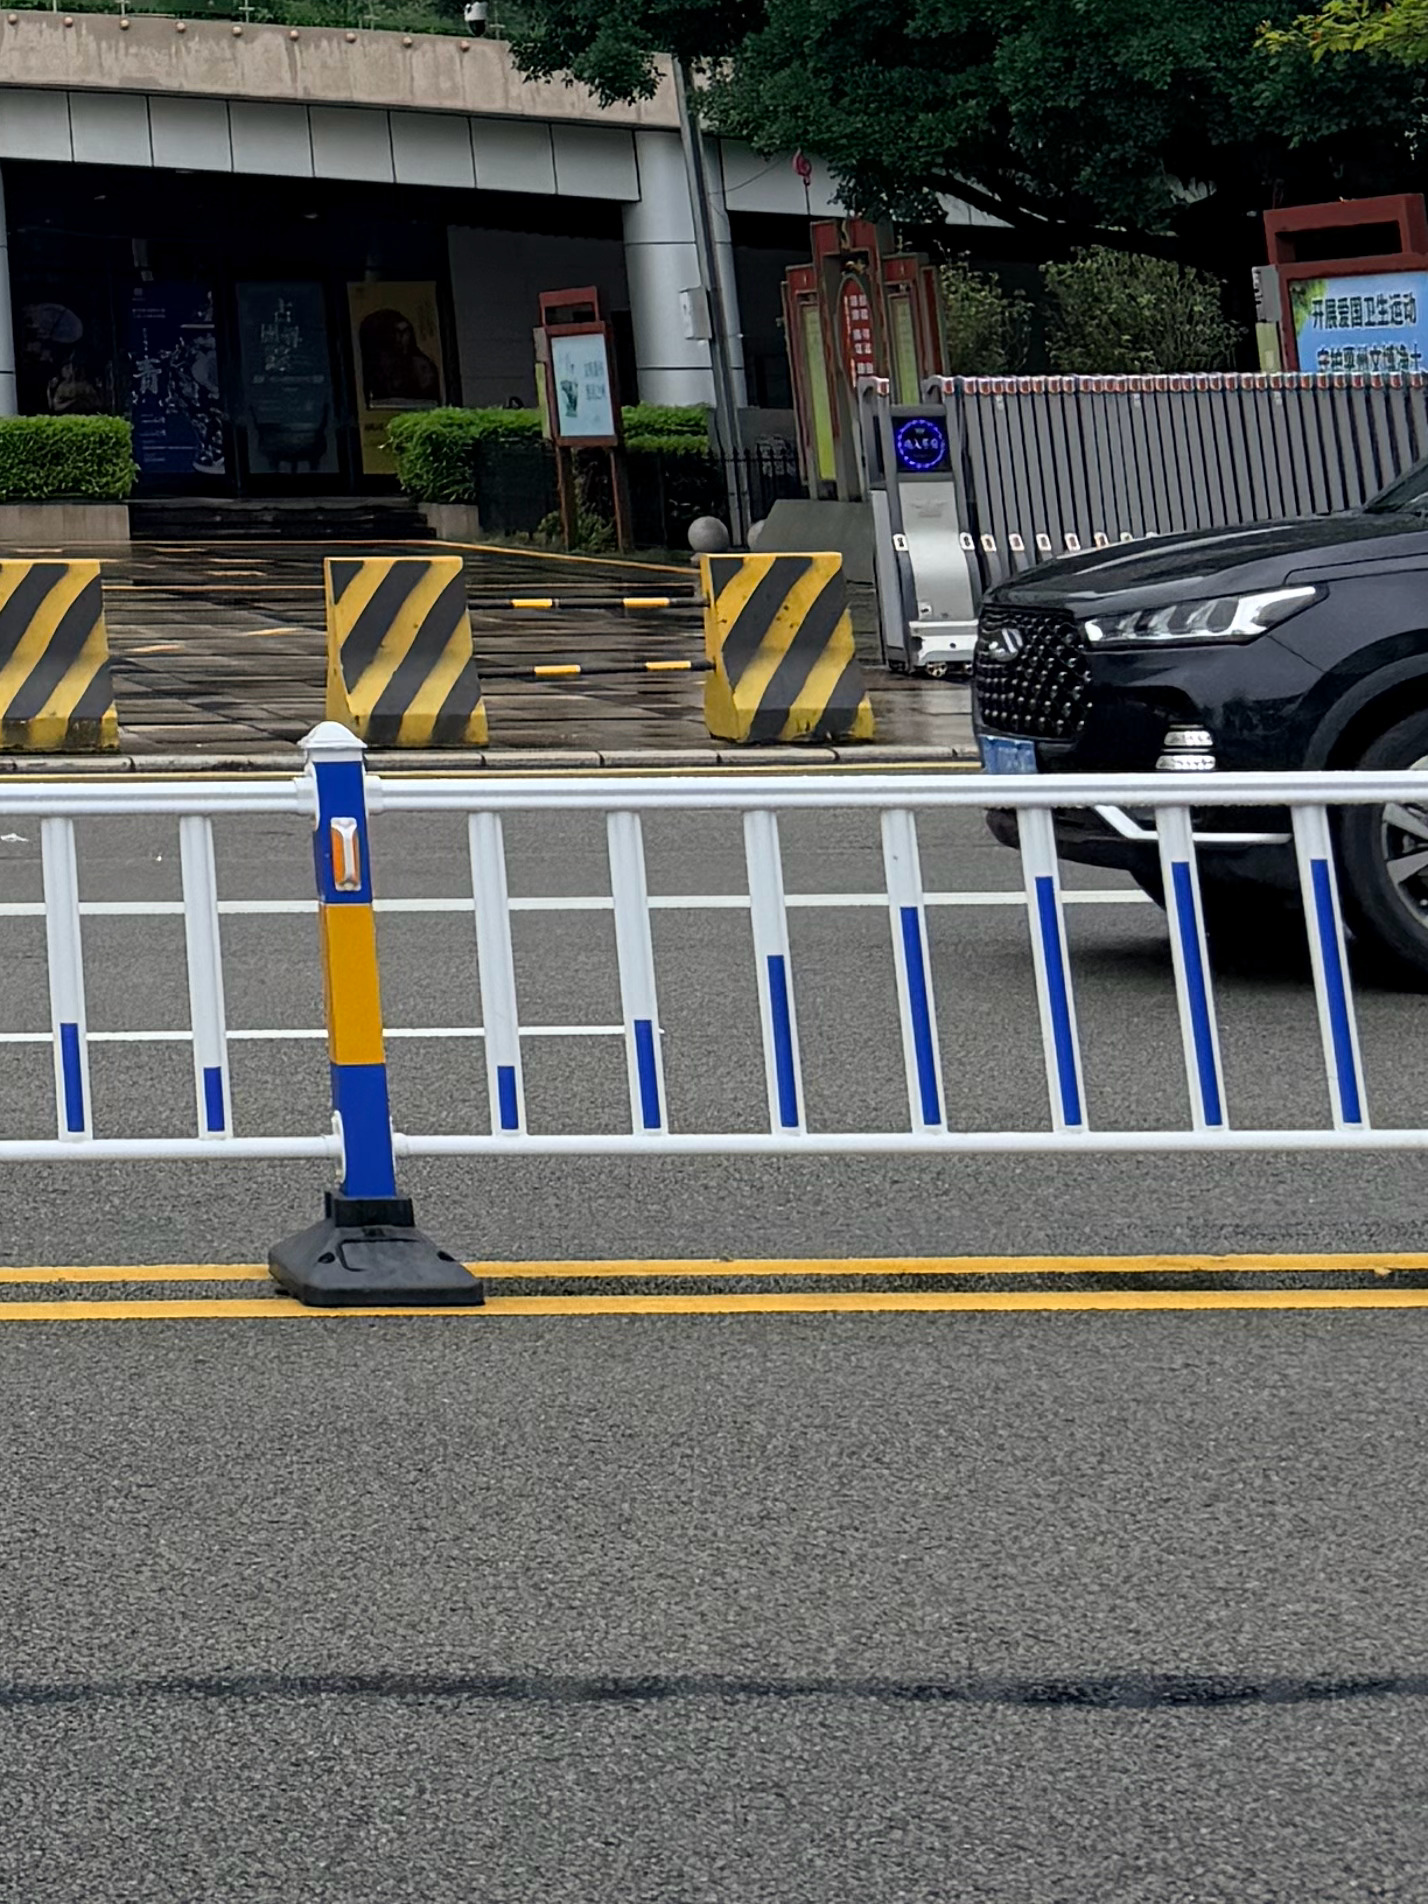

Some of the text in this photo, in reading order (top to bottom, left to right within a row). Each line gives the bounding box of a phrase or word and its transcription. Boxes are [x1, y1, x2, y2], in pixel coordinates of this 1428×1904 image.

[1312, 292, 1416, 330] 开展爱国卫生运动
